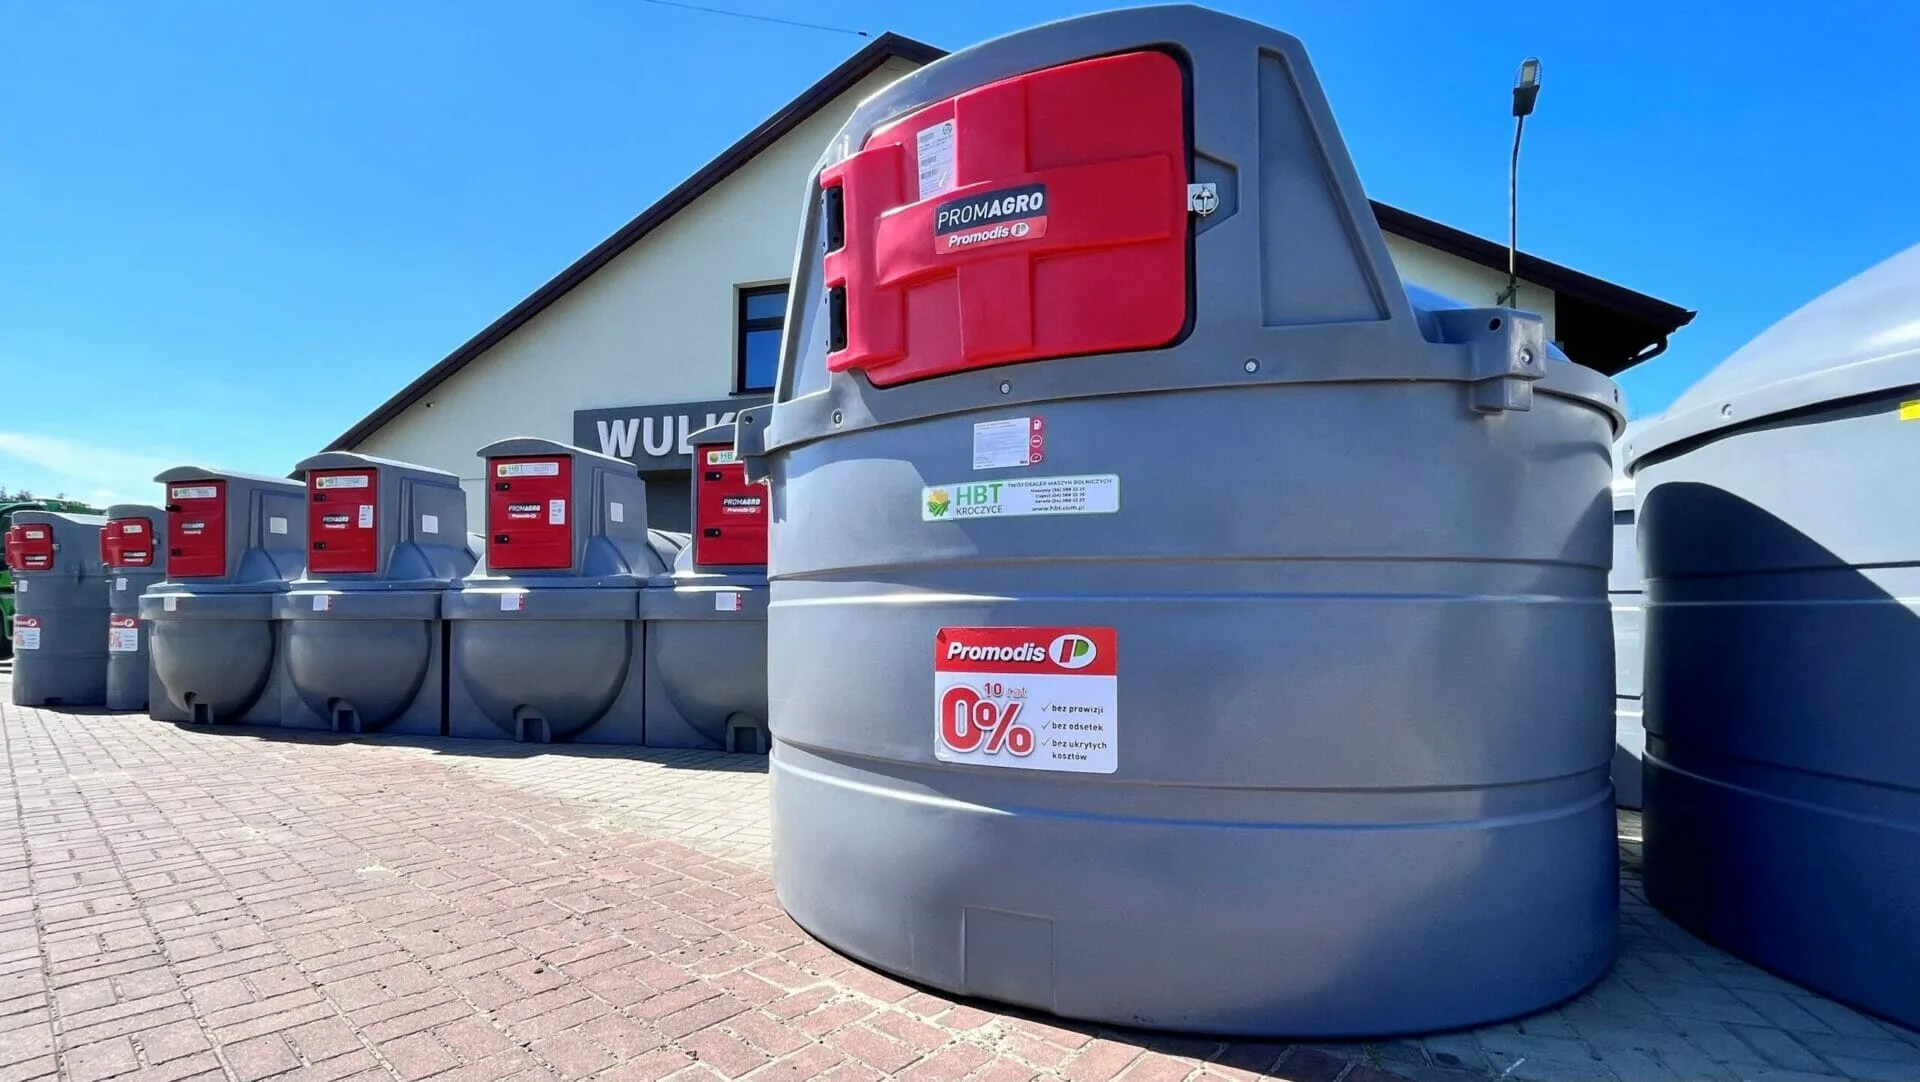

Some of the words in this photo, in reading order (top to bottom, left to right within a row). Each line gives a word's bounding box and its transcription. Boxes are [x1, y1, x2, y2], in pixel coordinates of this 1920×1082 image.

[937, 192, 1044, 229] PROMAGRO
[948, 225, 1010, 248] Promodis
[956, 483, 1003, 506] HBT
[956, 505, 1003, 516] KROCZYCE
[946, 642, 1047, 663] Promodis
[984, 682, 1003, 698] 10
[1006, 686, 1028, 699] rat
[1051, 702, 1067, 713] bez
[1068, 703, 1104, 714] prowizji
[940, 684, 1035, 757] 0%
[1051, 720, 1067, 730] bez
[1068, 720, 1104, 731] odsetek
[1051, 738, 1067, 748] bez
[1068, 739, 1108, 751] ukrytych
[1051, 751, 1088, 761] kosztów
